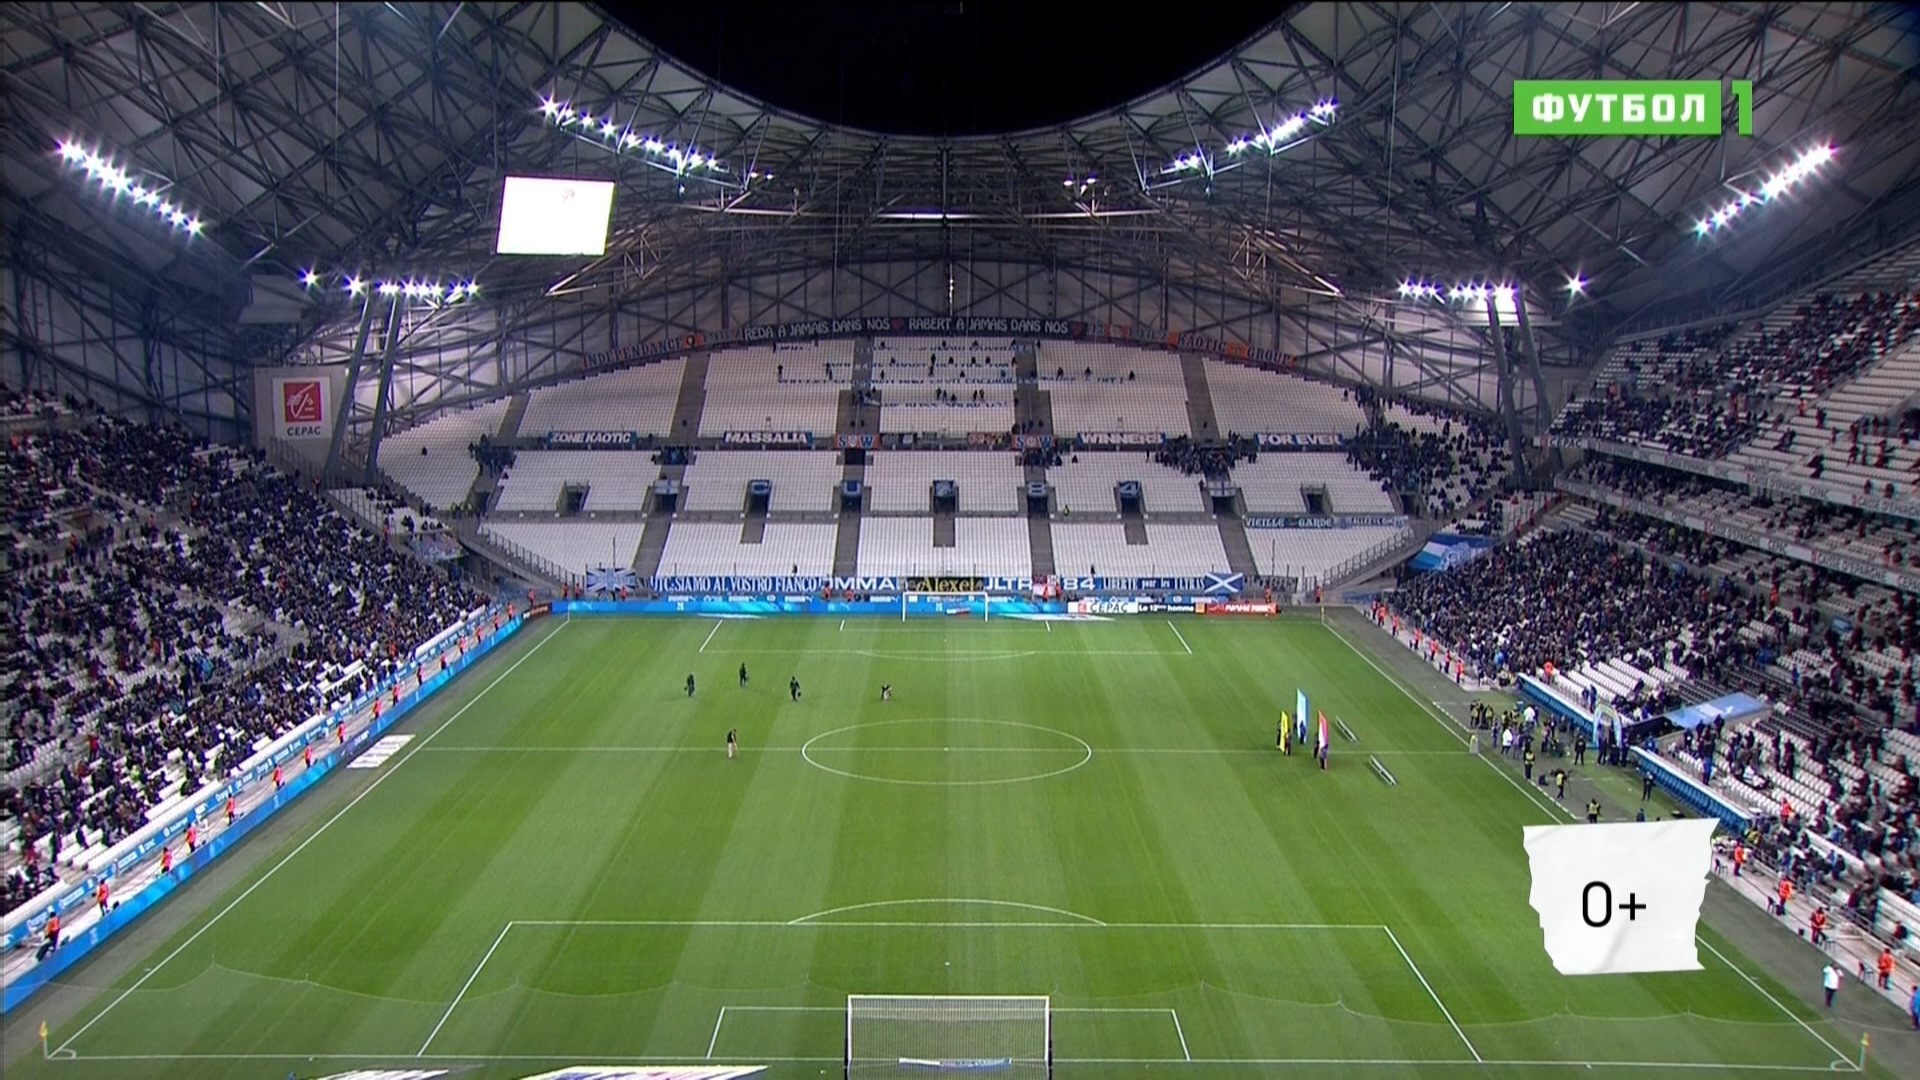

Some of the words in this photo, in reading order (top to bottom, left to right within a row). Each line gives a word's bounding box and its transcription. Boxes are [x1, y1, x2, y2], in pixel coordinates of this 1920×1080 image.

[744, 325, 774, 341] REDA
[778, 324, 787, 338] A
[789, 320, 829, 337] JAMAIS
[832, 318, 863, 333] DANS
[867, 317, 890, 331] NOS
[956, 318, 965, 331] A
[969, 318, 1008, 332] JAMAIS
[1010, 319, 1041, 333] DANS
[1044, 320, 1069, 334] NOS
[287, 426, 321, 436] CEPAC
[552, 432, 585, 444] ZONE
[587, 431, 631, 444] KAOTIC
[724, 432, 808, 443] MASSALIA
[1081, 433, 1164, 444] WINNERS
[1246, 517, 1285, 527] VIEILLE
[1298, 517, 1332, 527] GARDE
[713, 577, 729, 591] AL
[731, 576, 772, 591] VOSTRO
[1063, 577, 1095, 590] 84
[1090, 602, 1128, 612] CEPAC
